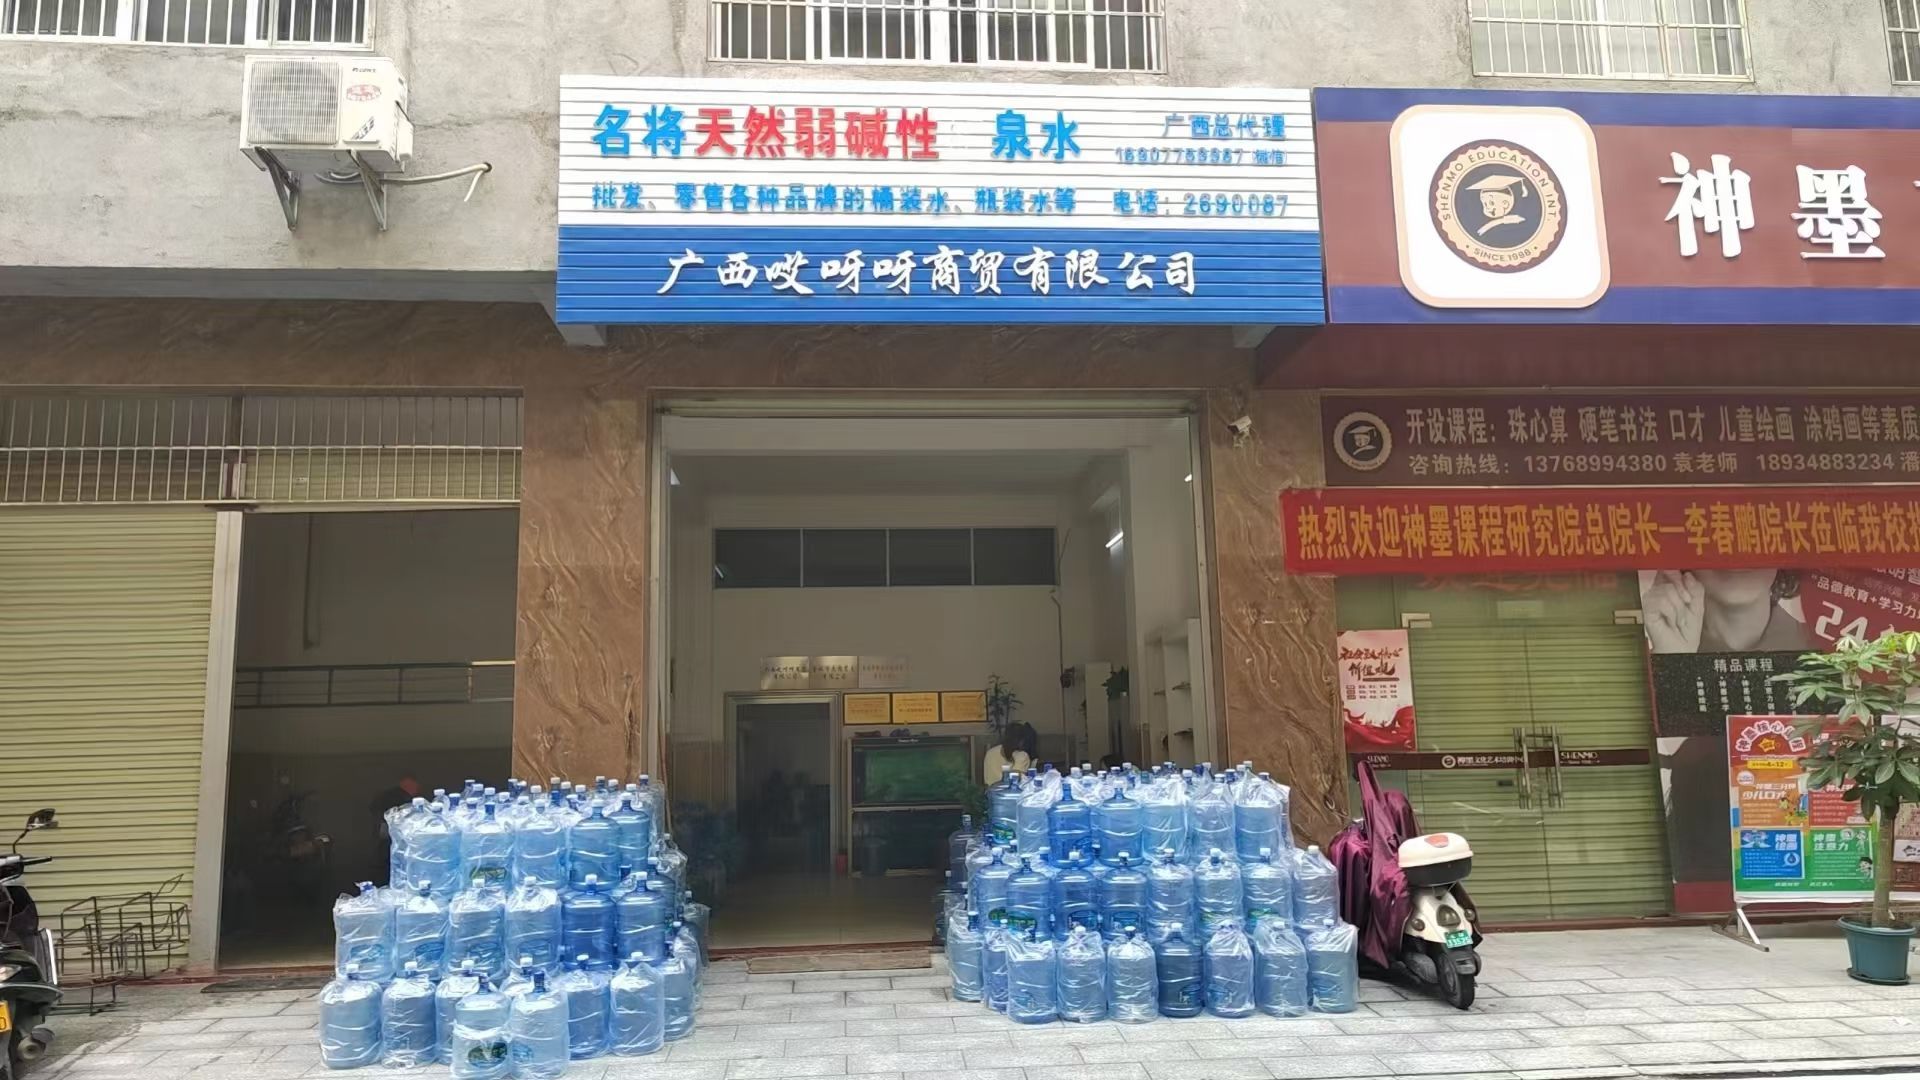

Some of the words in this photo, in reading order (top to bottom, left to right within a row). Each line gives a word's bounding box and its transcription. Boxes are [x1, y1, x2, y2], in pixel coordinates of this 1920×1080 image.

[991, 110, 1081, 164] 泉水
[1162, 112, 1287, 141] 广西总代理
[1441, 162, 1464, 221] SHENMO
[1468, 150, 1549, 188] EDUCATION
[1658, 151, 1920, 258] 神墨
[657, 246, 1197, 296] 广西哎呀呀商贸有限公司
[1474, 247, 1506, 262] SINCE
[1507, 248, 1532, 262] 1998
[1578, 405, 1659, 443] 硬笔书法
[1668, 406, 1705, 442] 口才
[1719, 405, 1795, 442] 儿童绘画
[1756, 452, 1894, 471] 18934883234
[1714, 658, 1774, 672] 精品课程
[1560, 752, 1598, 760] SHENMO
